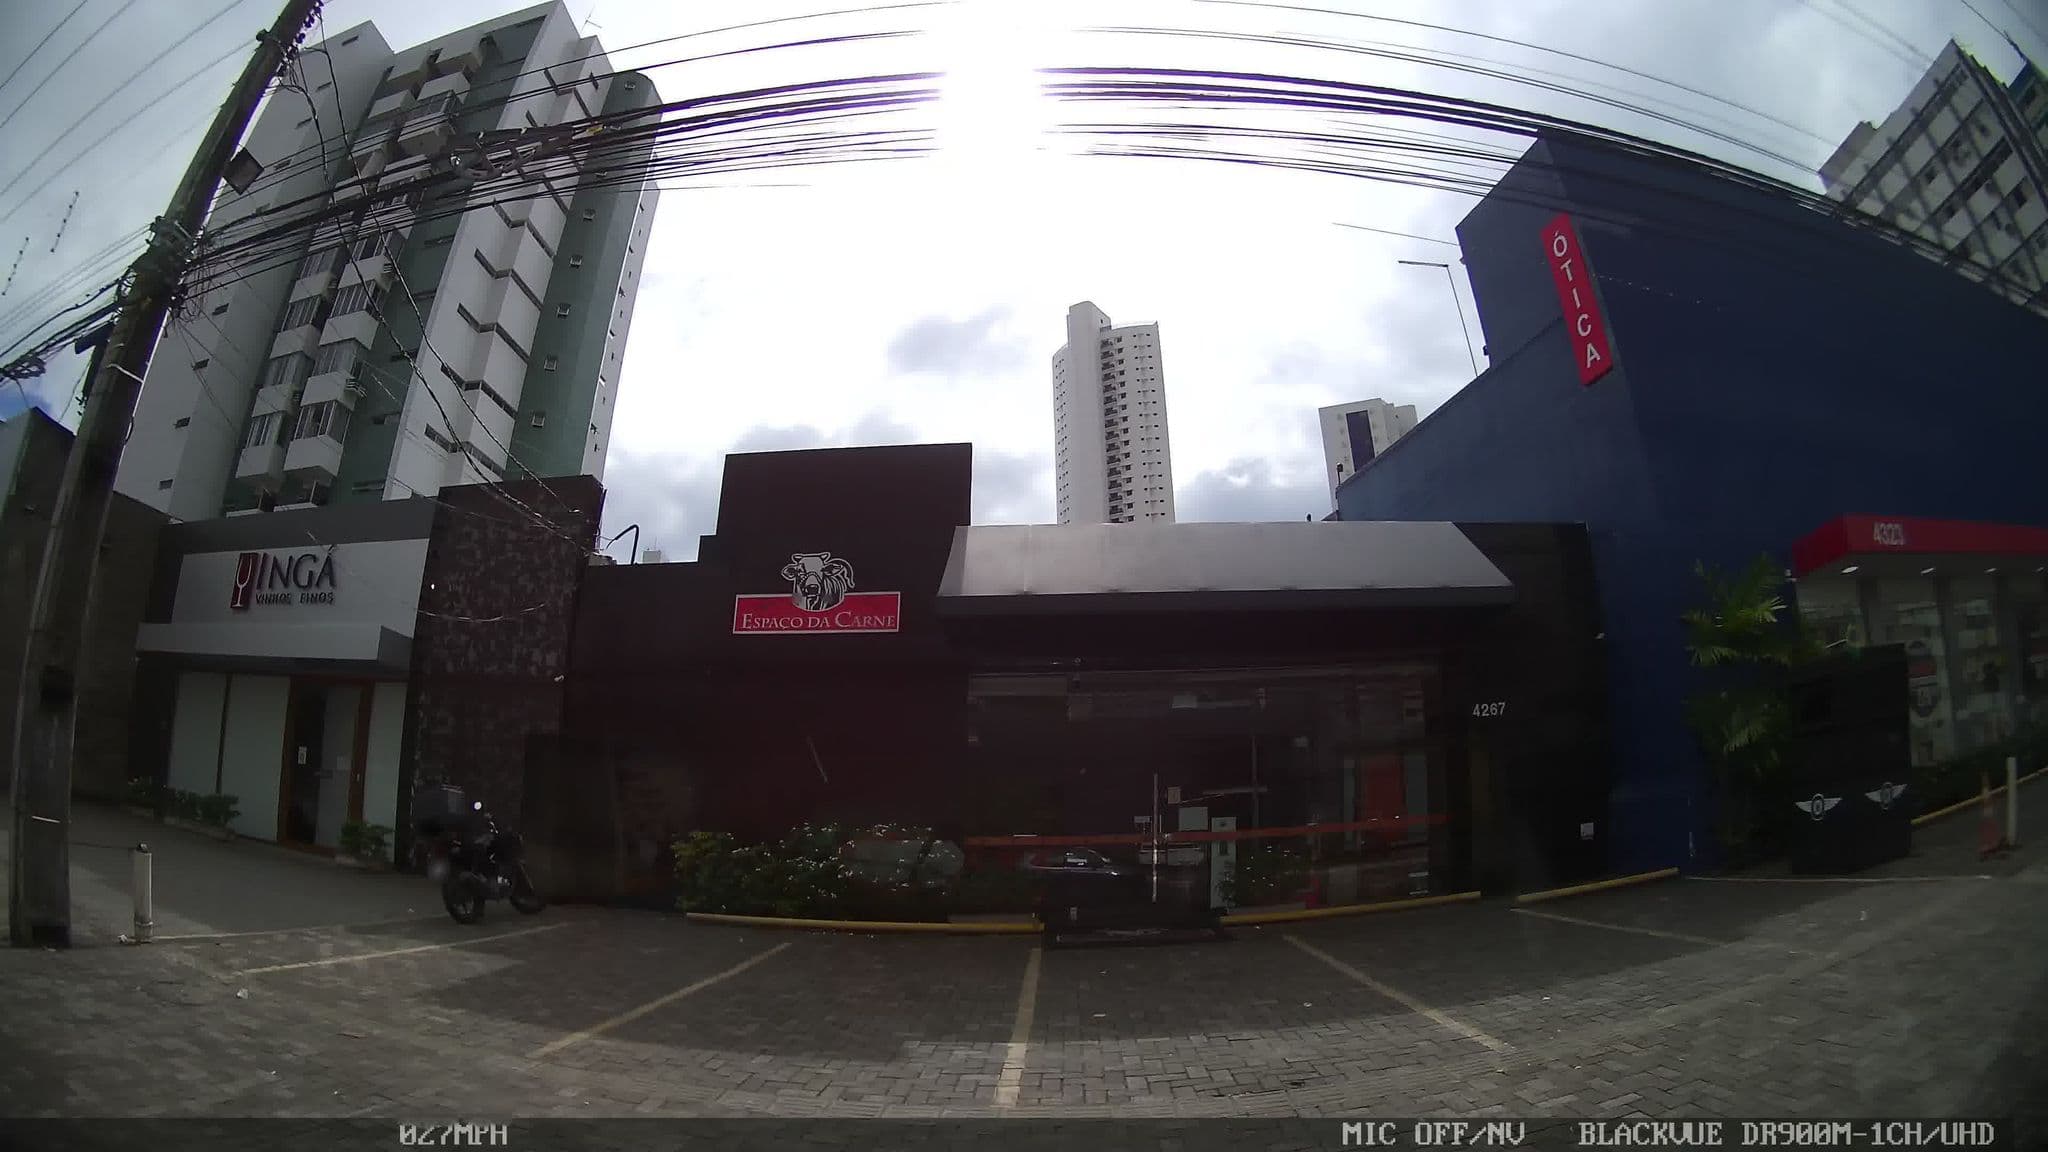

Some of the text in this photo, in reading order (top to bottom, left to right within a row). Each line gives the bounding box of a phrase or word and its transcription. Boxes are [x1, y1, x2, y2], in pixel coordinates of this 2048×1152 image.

[1553, 229, 1601, 369] ÓTICA
[256, 544, 337, 590] INGÁ
[256, 592, 292, 605] VINHOS
[742, 611, 895, 630] ESPAÇO DA CARNE
[1472, 701, 1506, 717] 4267
